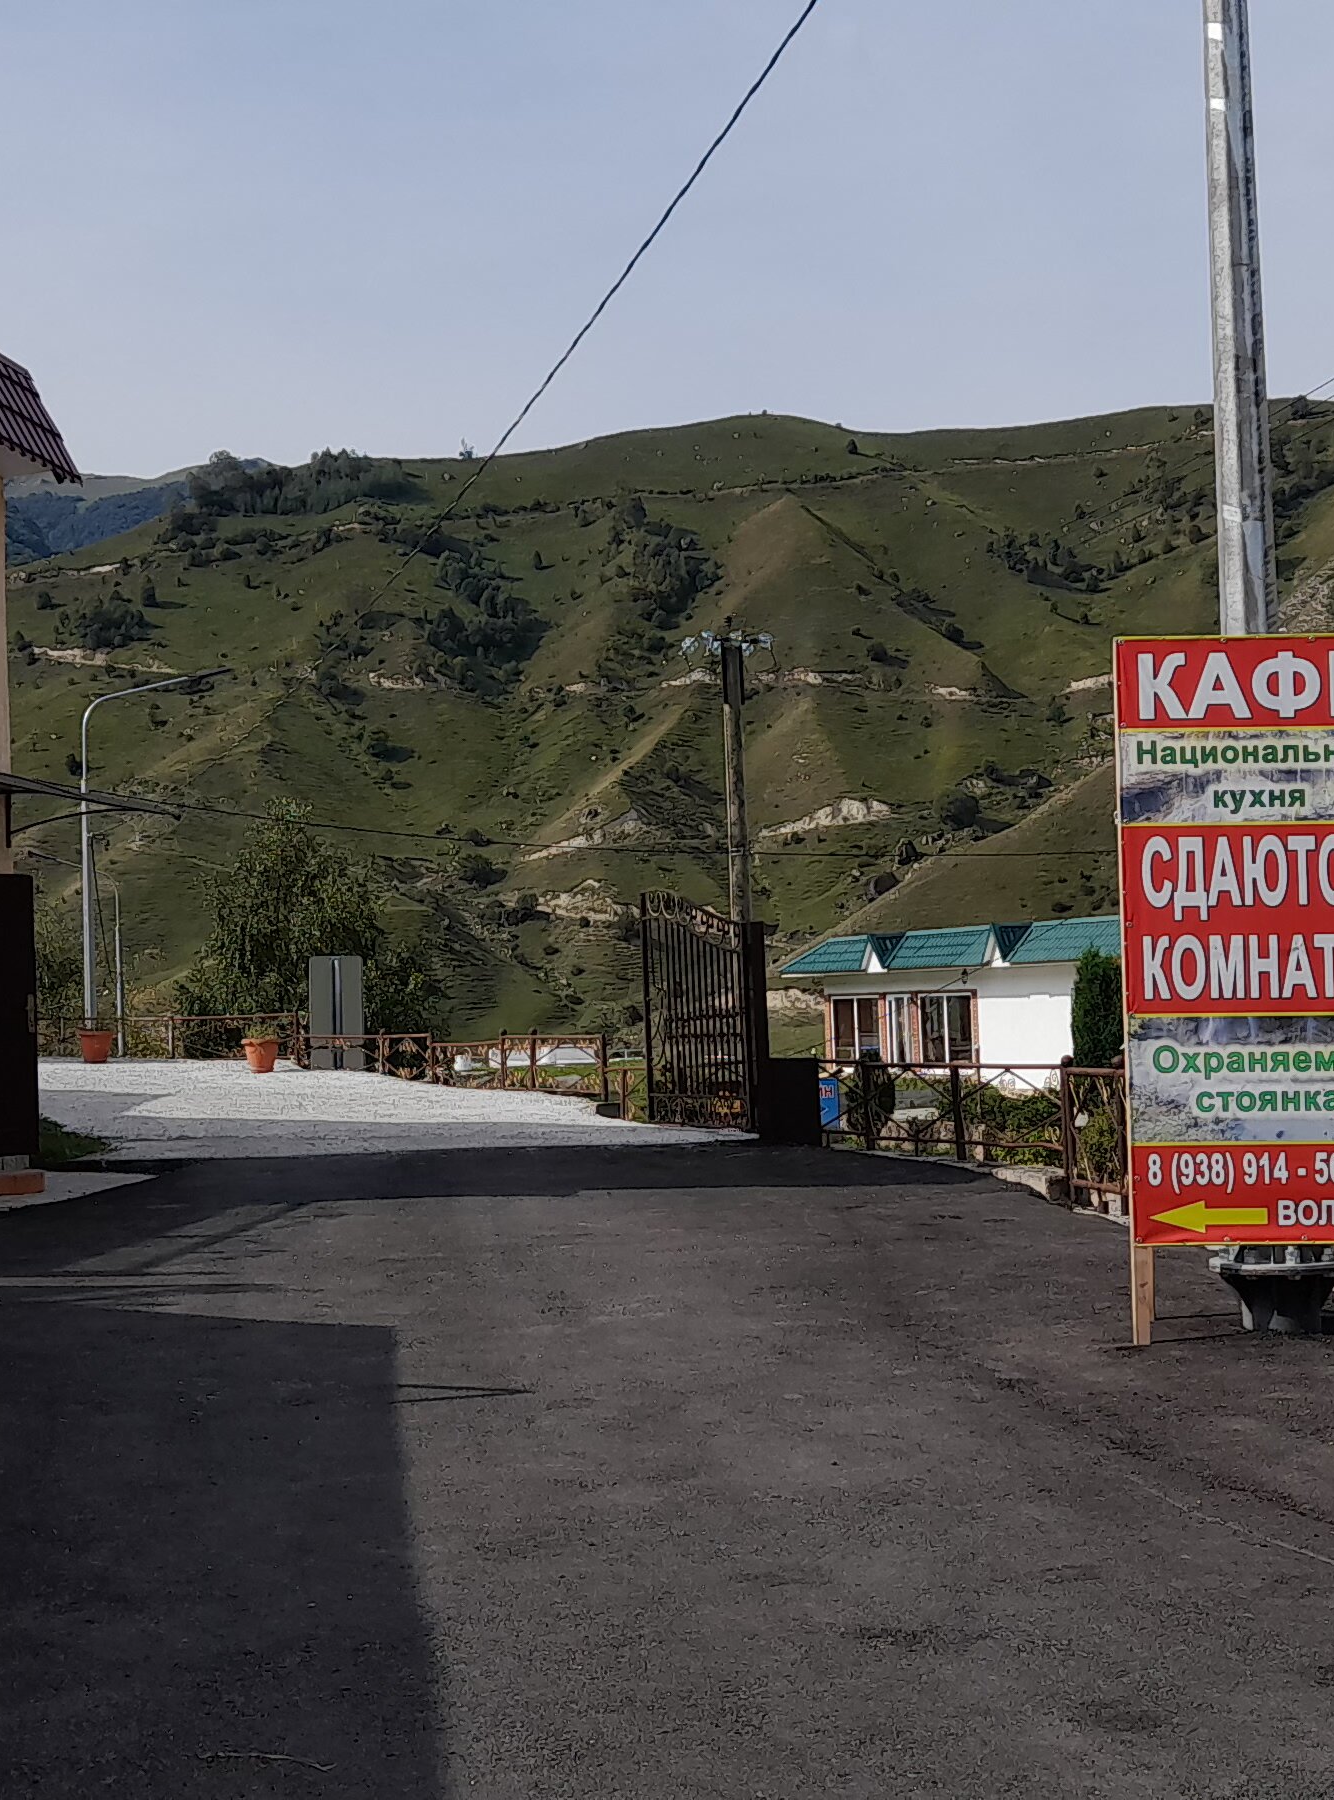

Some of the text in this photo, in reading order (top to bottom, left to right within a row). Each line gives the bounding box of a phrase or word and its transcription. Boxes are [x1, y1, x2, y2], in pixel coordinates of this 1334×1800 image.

[1213, 788, 1306, 814] кухня
[1147, 1153, 1163, 1186] 8
[1171, 1151, 1234, 1194] (938)
[1242, 1151, 1289, 1185] 914
